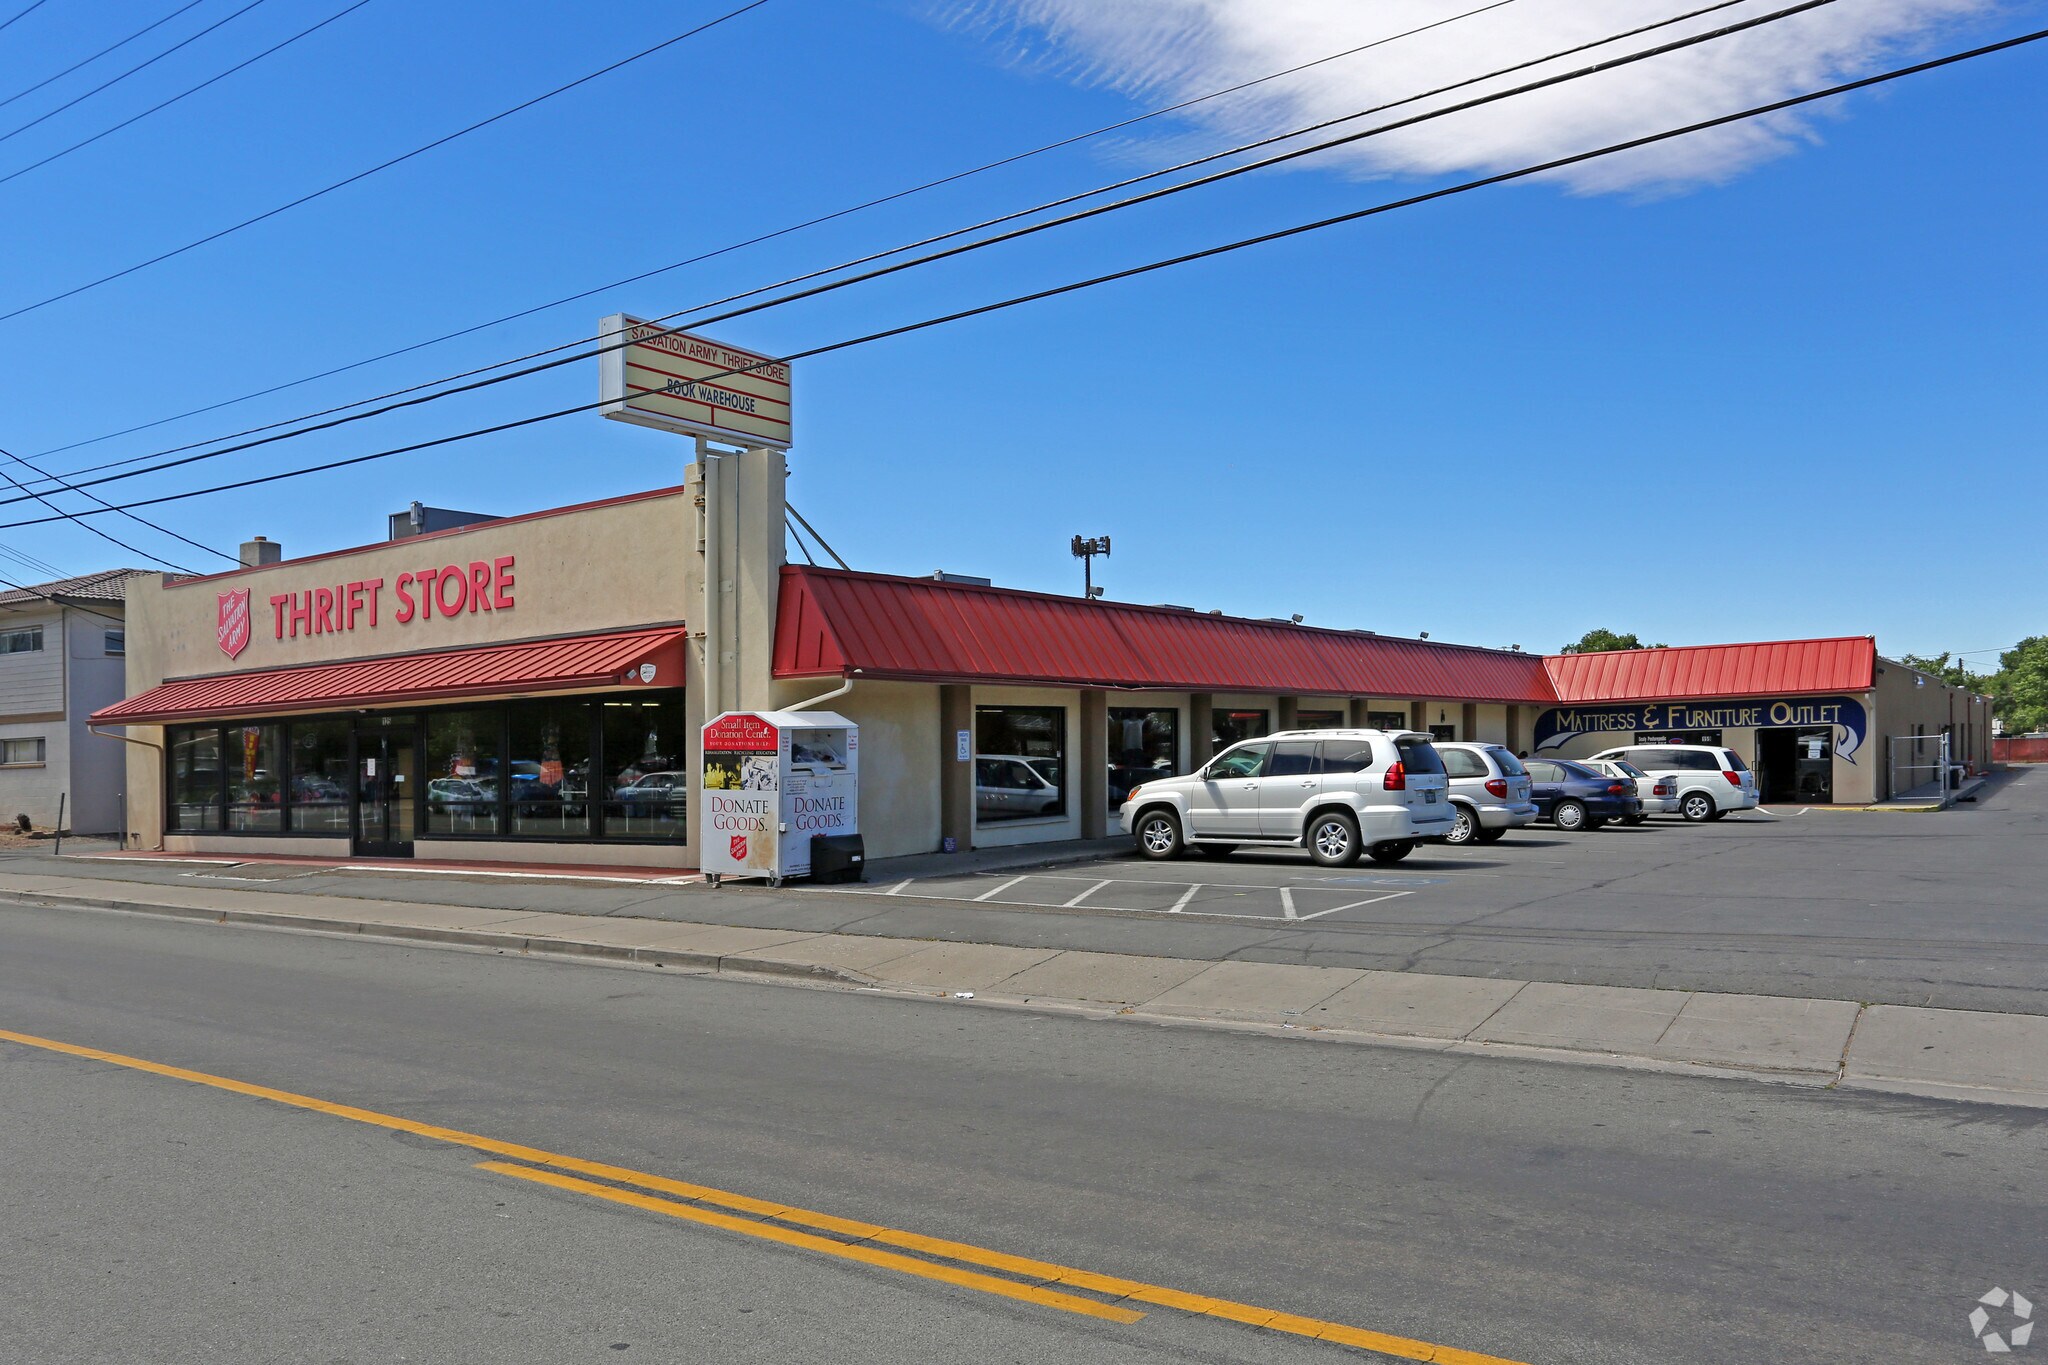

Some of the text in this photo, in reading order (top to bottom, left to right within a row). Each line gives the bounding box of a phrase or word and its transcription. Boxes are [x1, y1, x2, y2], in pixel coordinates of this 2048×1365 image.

[632, 327, 785, 380] SALVATION ARMY THRIFT STORE
[667, 378, 755, 412] BOOK WAREHOUSE
[223, 595, 235, 618] THE
[270, 555, 514, 639] THRIFT STORE
[218, 596, 246, 642] SALVATION
[228, 617, 246, 650] ARMY
[721, 719, 760, 729] Small Item
[1556, 701, 1842, 732] MATTRESS & FURNITURE OUTLET
[710, 728, 743, 739] Donation
[711, 796, 769, 814] DONATE
[794, 796, 845, 814] DONATE
[714, 813, 768, 832] GOODS.
[795, 814, 844, 831] GOODS.
